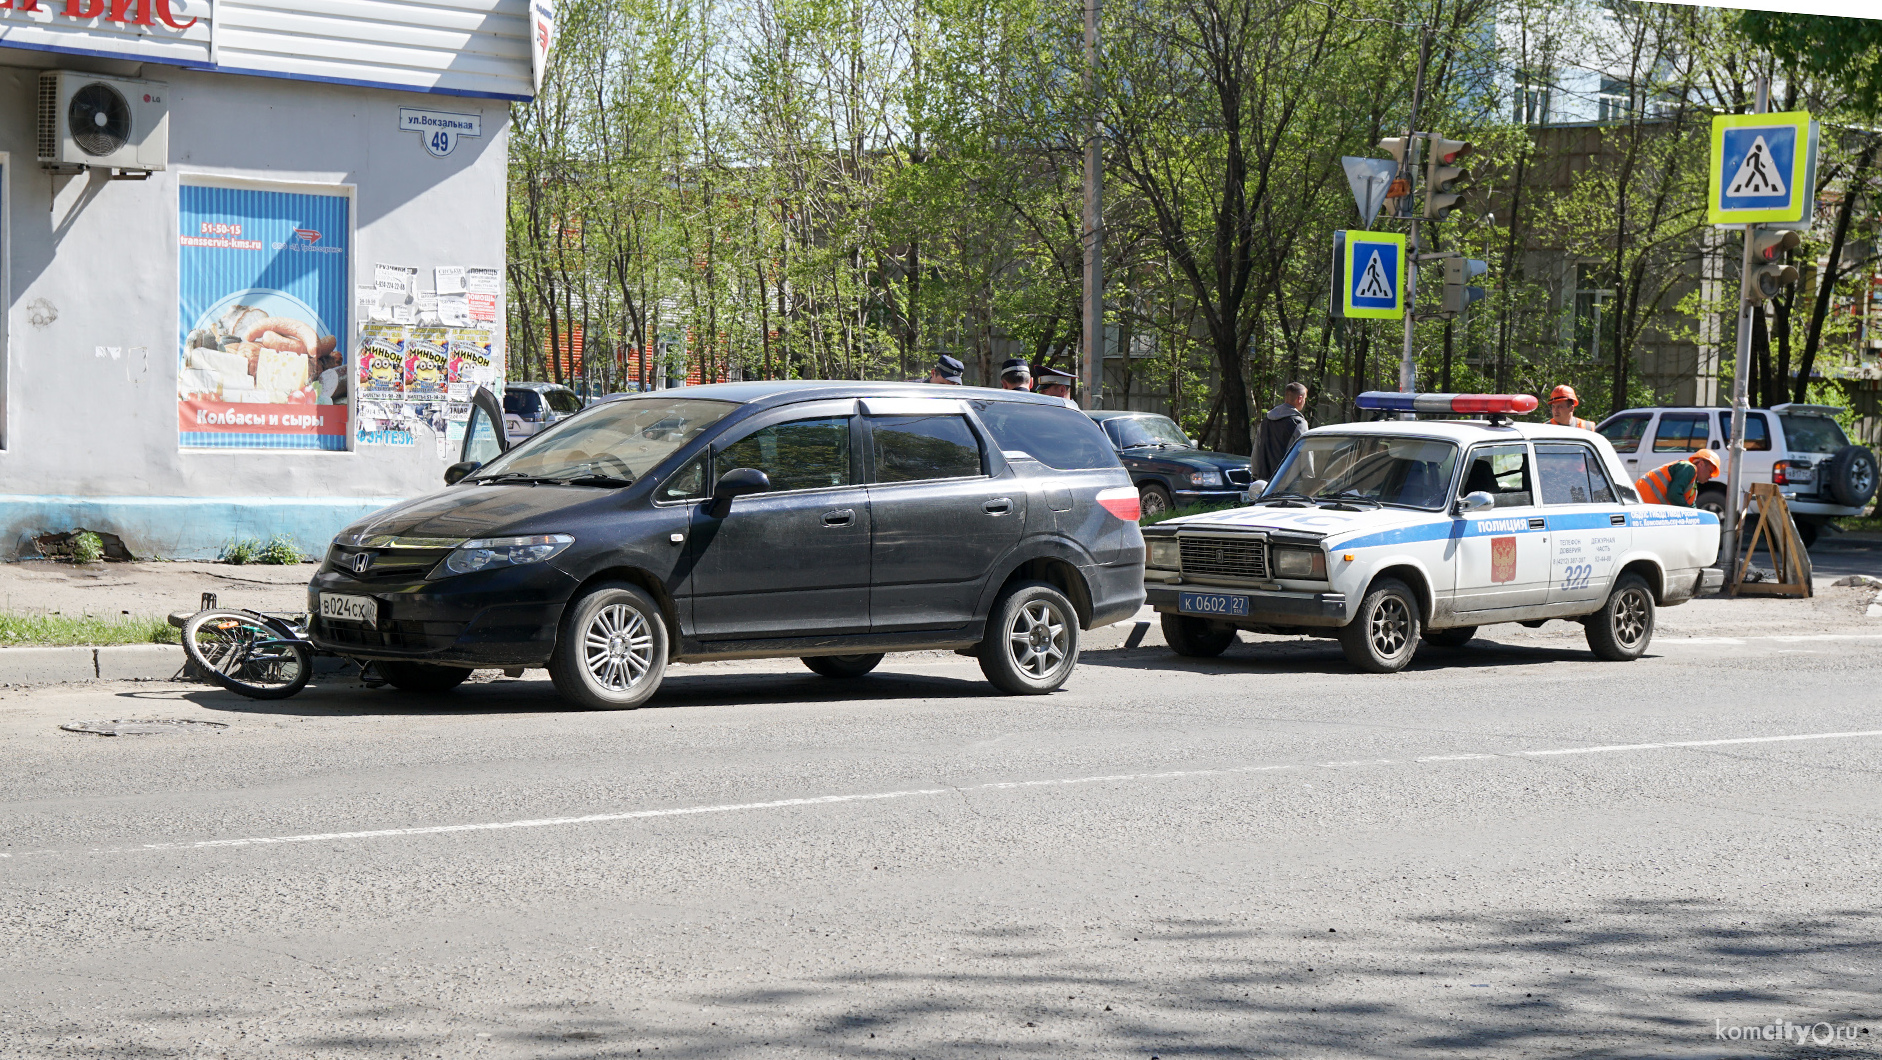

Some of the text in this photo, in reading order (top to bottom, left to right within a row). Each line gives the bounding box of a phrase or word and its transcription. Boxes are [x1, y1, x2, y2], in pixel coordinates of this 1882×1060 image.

[408, 116, 473, 129] ул.Вокзальная
[432, 132, 448, 151] 49
[201, 222, 241, 235] 51-50-15
[180, 236, 262, 250] transservis-kms.ru
[471, 268, 498, 276] ПОМОЩЬ
[364, 345, 403, 363] МИНЬОН
[410, 348, 447, 365] МИНЬОН
[454, 350, 489, 367] МИНЬОН
[196, 408, 323, 428] Колбасы и сыры
[357, 430, 414, 444] ФЭНТЕЗИ
[1477, 519, 1527, 533] ПОЛИЦИЯ
[1561, 564, 1592, 591] 322
[324, 598, 365, 618] В024СХ
[1186, 596, 1226, 612] К 0602
[1233, 598, 1244, 609] 27
